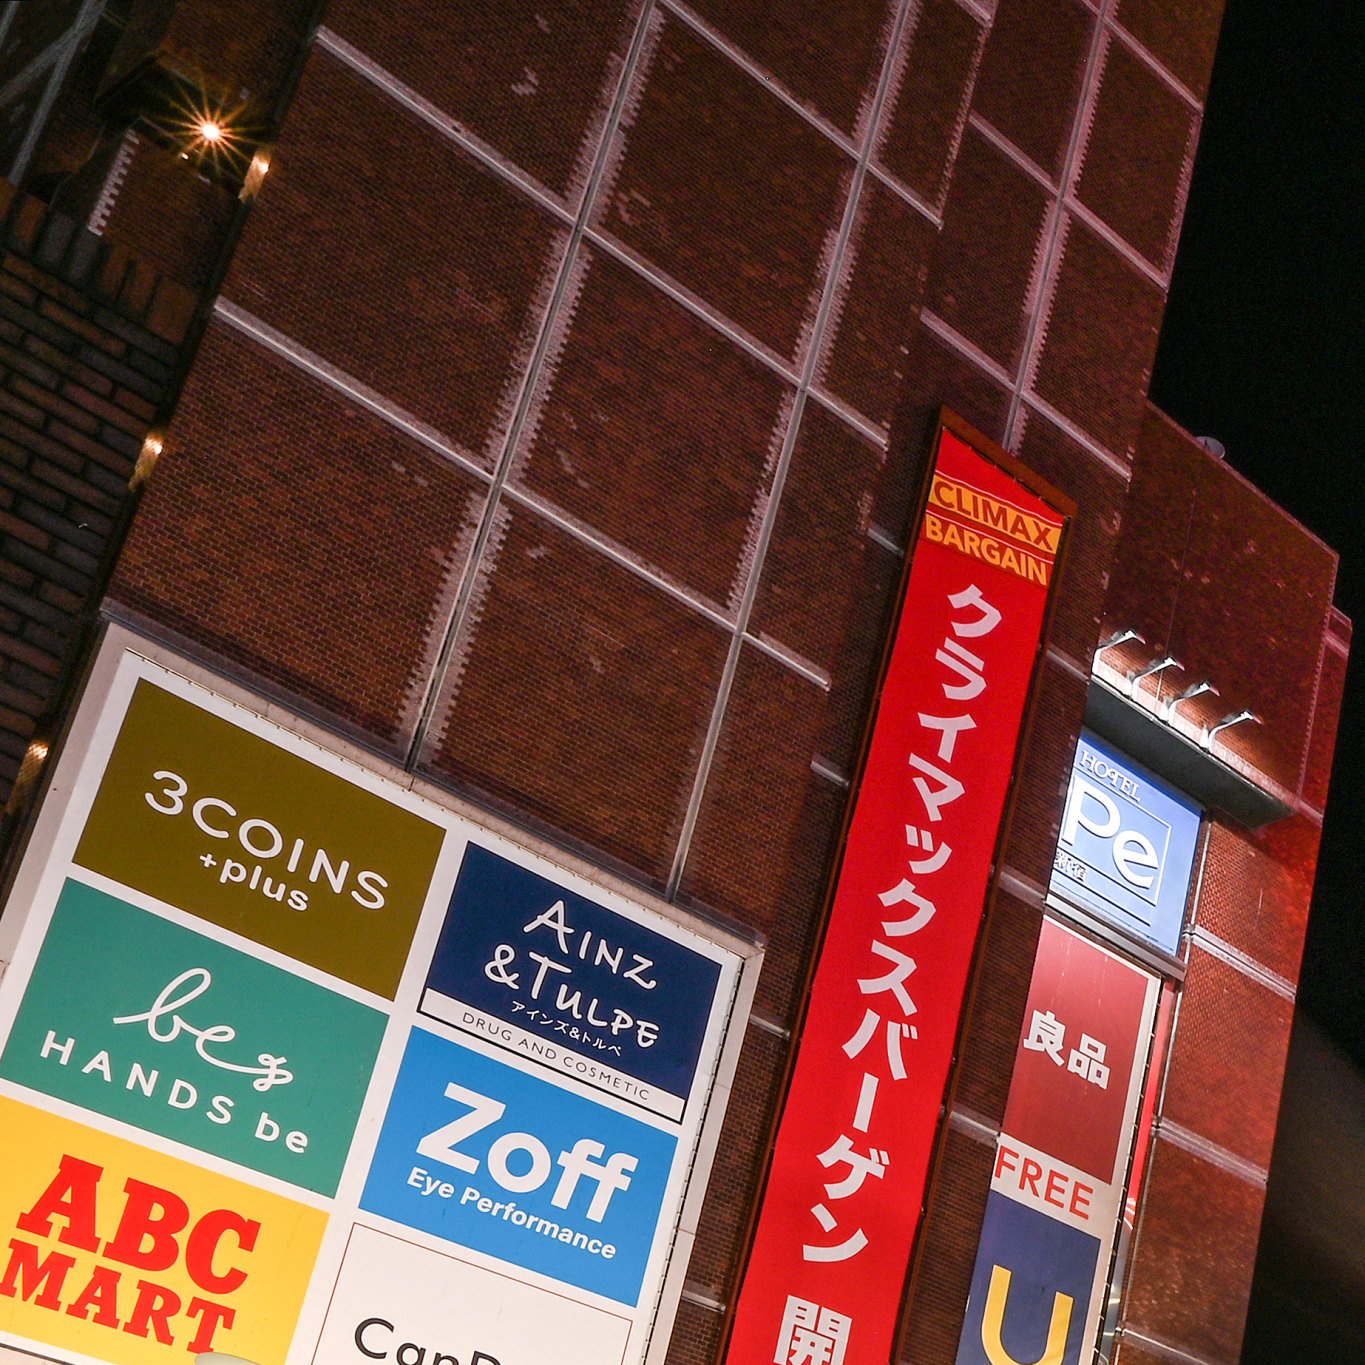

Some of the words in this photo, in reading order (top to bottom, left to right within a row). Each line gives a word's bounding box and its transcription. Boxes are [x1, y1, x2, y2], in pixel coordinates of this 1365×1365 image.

[924, 516, 1048, 586] BARGAIN
[932, 479, 1056, 551] CLIMAX
[1079, 750, 1141, 803] HOTEL
[145, 769, 389, 912] 3COINS
[199, 852, 310, 913] +plus
[523, 899, 658, 992] AINZ
[800, 584, 1001, 1262] クライマックスバーゲン
[39, 1033, 236, 1127] HANDS
[254, 1110, 311, 1155] be
[462, 1011, 512, 1042] DRUG
[518, 1037, 557, 1061] AND
[562, 1055, 650, 1101] COSMETIC
[1022, 1008, 1112, 1092] 良品
[416, 1082, 640, 1224] Zoff
[994, 1144, 1094, 1222] FREE
[16, 1154, 262, 1297] ABC
[406, 1165, 456, 1206] Eye
[460, 1185, 618, 1262] Performance
[0, 1238, 237, 1356] MART
